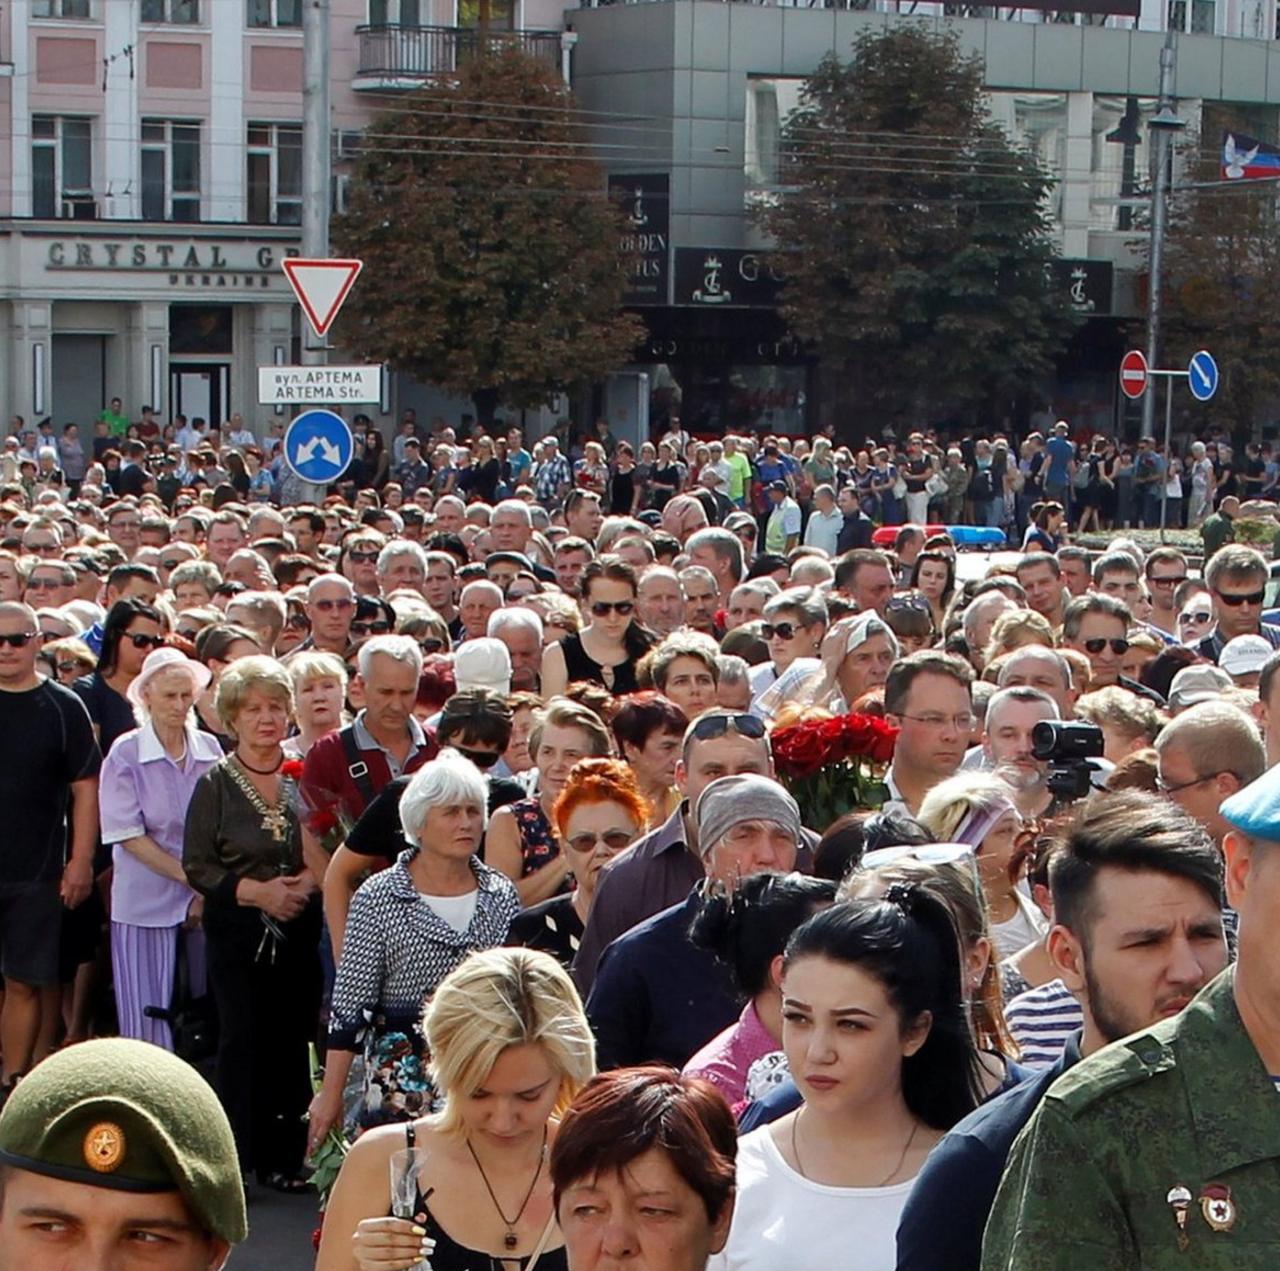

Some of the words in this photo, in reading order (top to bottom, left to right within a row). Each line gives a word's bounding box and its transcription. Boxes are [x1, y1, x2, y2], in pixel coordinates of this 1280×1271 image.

[48, 242, 226, 268] CRYSTAL
[169, 274, 269, 287] UKRAINE
[275, 374, 300, 386] вул.
[306, 372, 363, 384] АРТЕМА
[276, 386, 335, 399] ARTEMA
[339, 386, 365, 399] Str.
